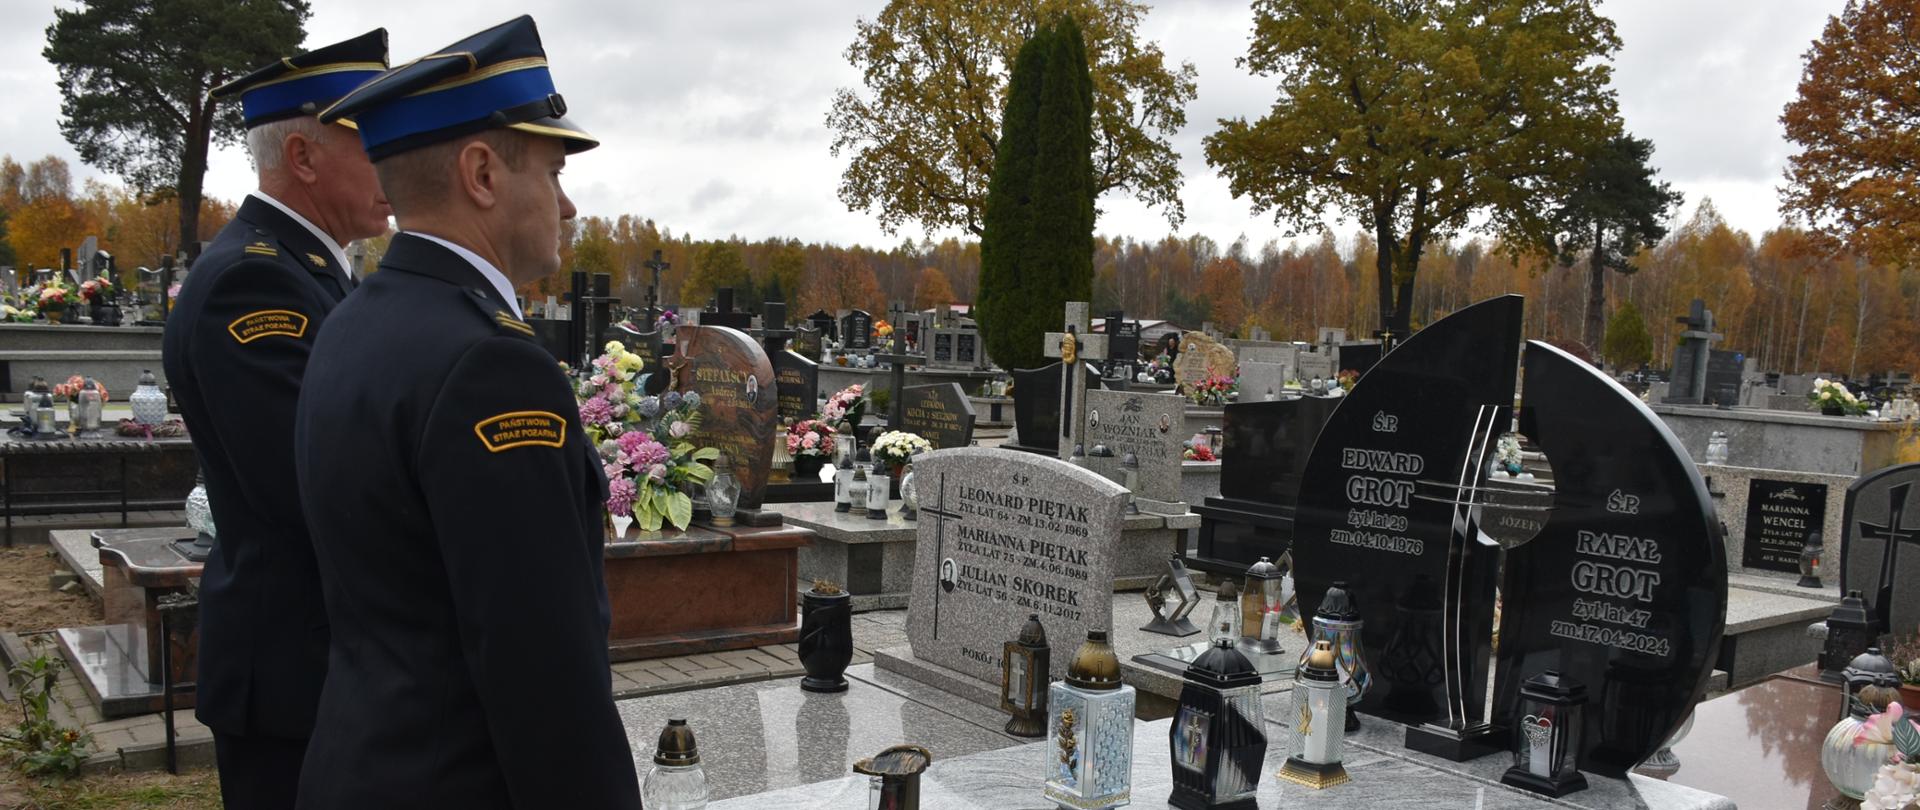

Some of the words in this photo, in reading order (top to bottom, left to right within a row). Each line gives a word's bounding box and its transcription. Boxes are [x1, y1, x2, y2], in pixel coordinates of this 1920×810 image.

[499, 418, 550, 430] PAŃSTWOWA
[1103, 422, 1156, 439] WOŹNIAK
[1120, 414, 1141, 425] JAN
[1372, 410, 1398, 432] Ś.P.
[1342, 448, 1424, 475] EDWARD
[1346, 475, 1415, 508] GROT
[1607, 488, 1640, 514] Ś.P.
[959, 486, 1023, 510] LEONARD
[1029, 497, 1089, 524] PIĘTAK
[959, 500, 975, 514] ŻYŁ
[978, 506, 994, 518] LAT
[997, 510, 1009, 521] 64
[1761, 504, 1811, 515] MARIANNA
[1348, 508, 1371, 529] żył
[1371, 511, 1388, 530] lat
[1389, 515, 1408, 532] 29
[1763, 515, 1807, 529] WENCEL
[957, 525, 1025, 552] MARIANNA
[1030, 539, 1089, 567] PIĘTAK
[958, 539, 980, 555] ŻYŁA
[983, 546, 1001, 560] LAT
[1003, 552, 1015, 563] 75
[1330, 528, 1424, 555] zm.04.10.1976
[1576, 530, 1662, 564] RAFAŁ
[957, 577, 974, 592] ŻYŁ
[976, 584, 993, 597] LAT
[995, 590, 1007, 601] 56
[960, 565, 1007, 588] JULIAN
[1012, 576, 1078, 607] SKOREK
[1571, 561, 1661, 602] GROT
[1572, 597, 1601, 622] żył
[1602, 602, 1625, 625] lat
[1626, 608, 1652, 628] 47
[1550, 620, 1670, 656] zm.17.04.2024
[962, 647, 992, 665] POKÓJ
